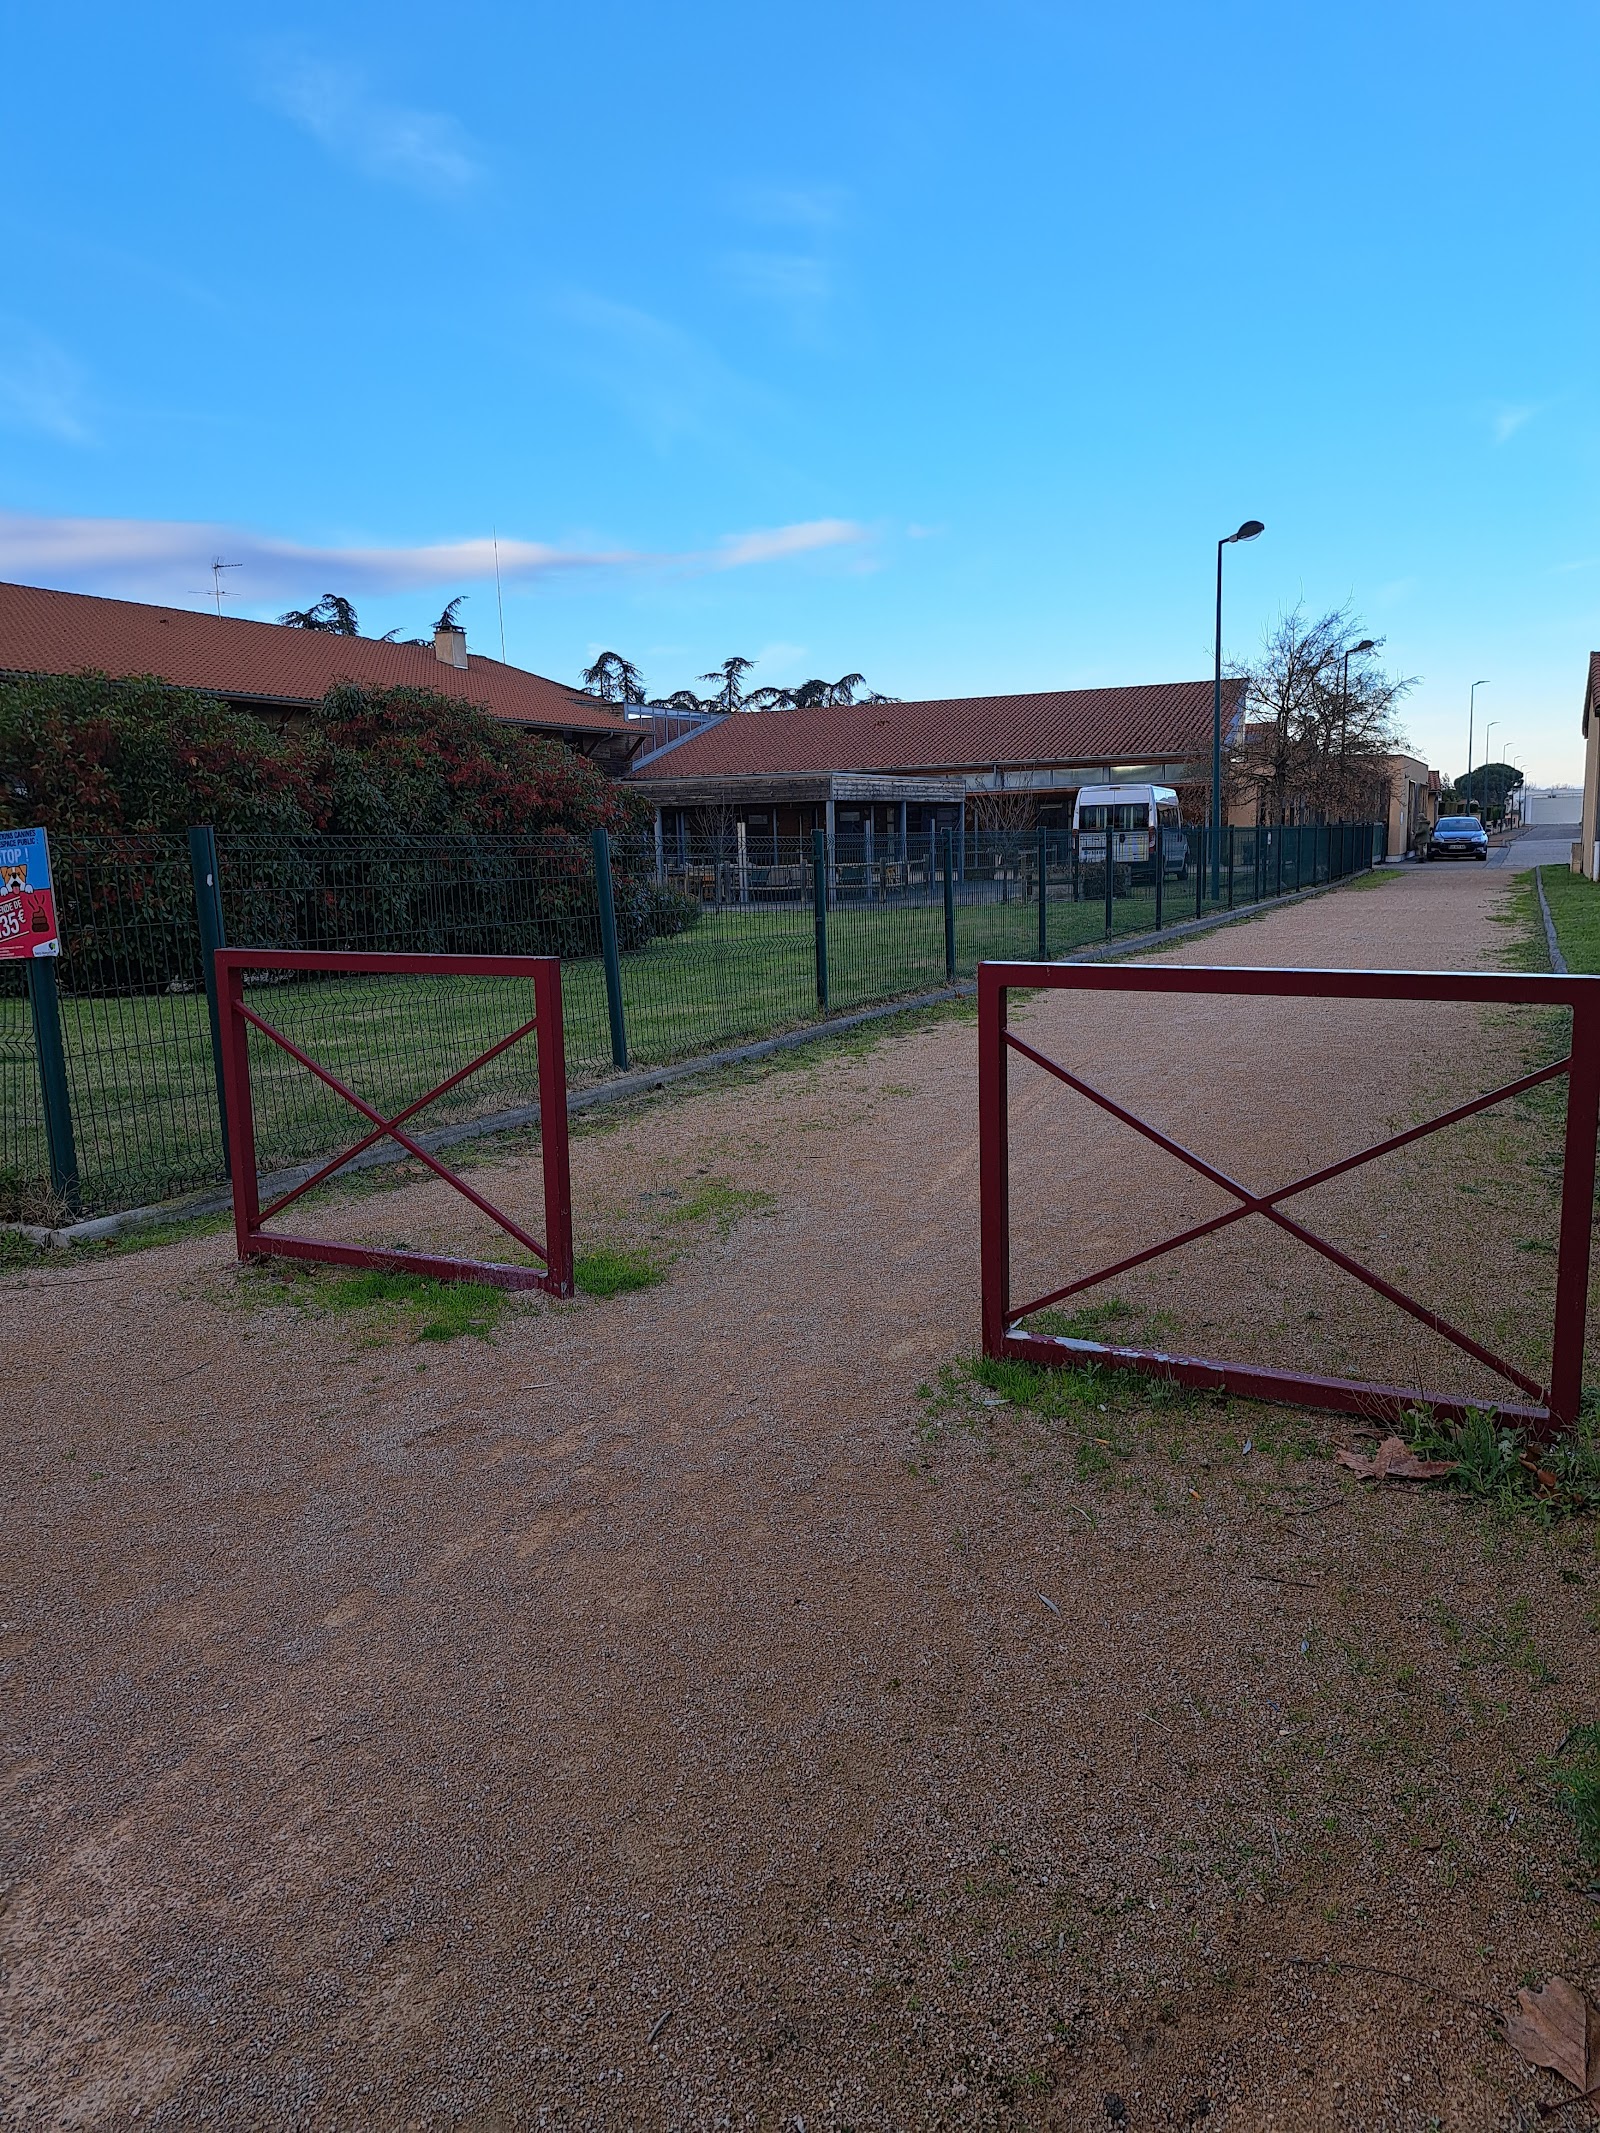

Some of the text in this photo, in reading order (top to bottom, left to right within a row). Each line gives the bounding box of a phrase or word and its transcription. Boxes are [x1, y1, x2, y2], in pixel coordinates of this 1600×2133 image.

[14, 829, 36, 838] CANINES
[17, 837, 35, 846] PUBLIC
[13, 899, 22, 910] DE
